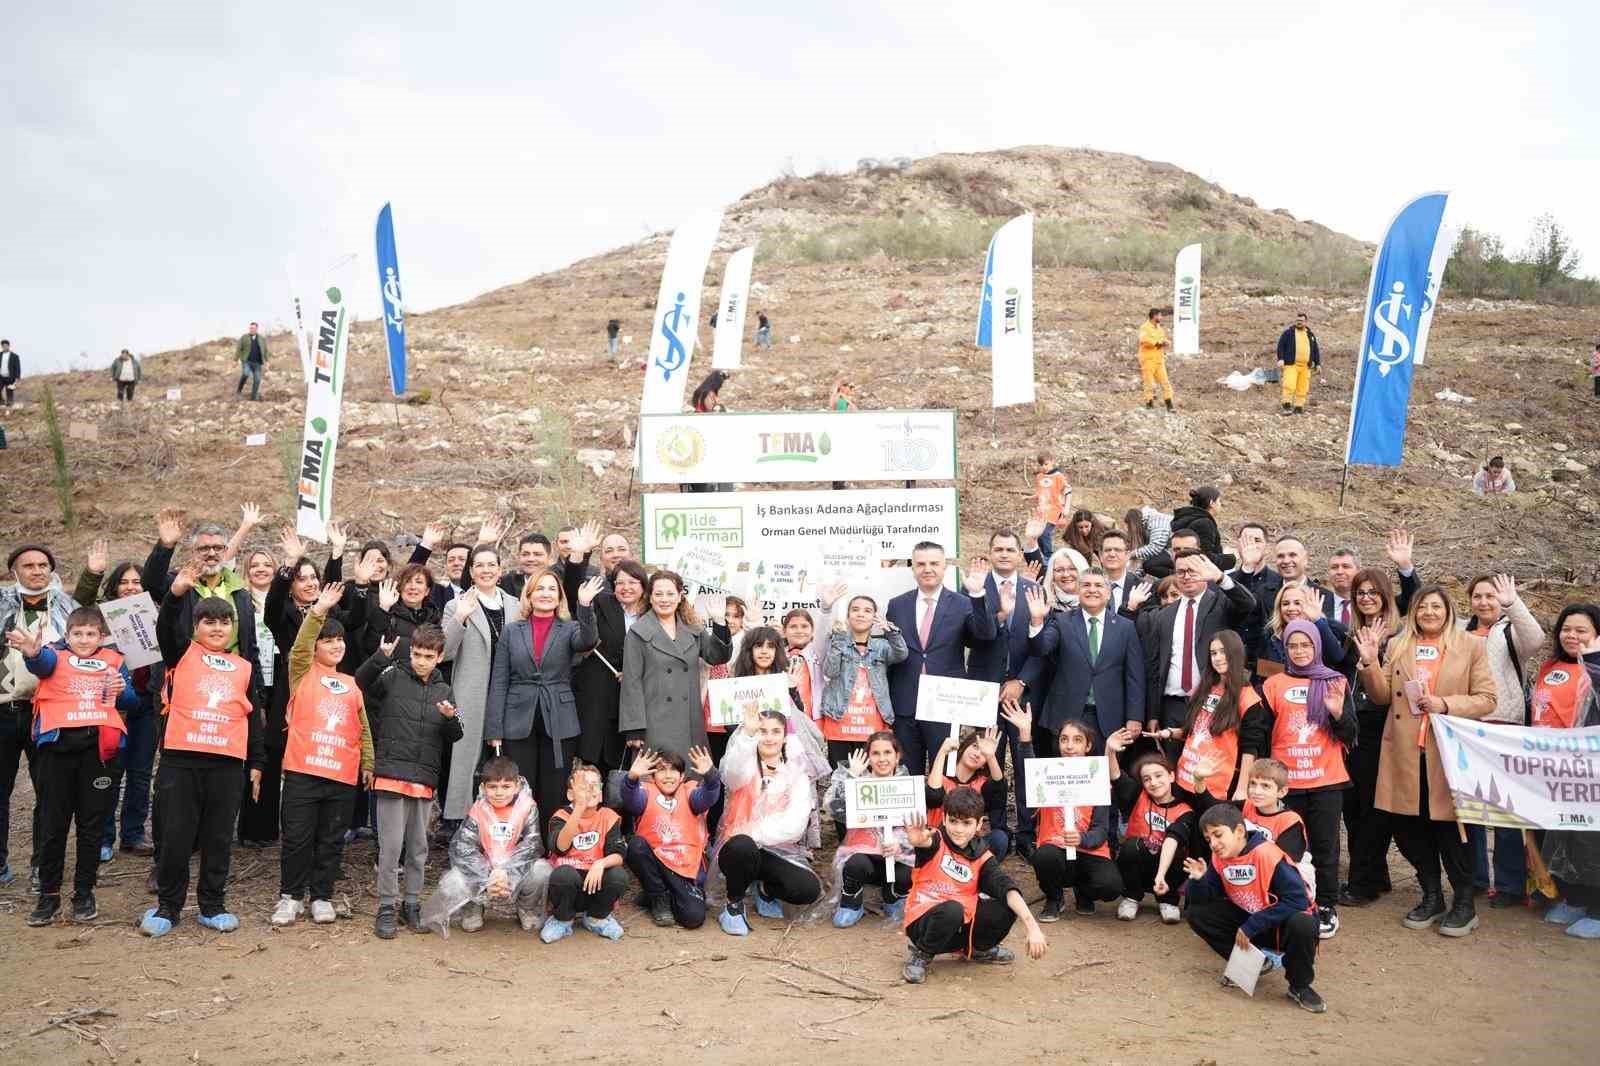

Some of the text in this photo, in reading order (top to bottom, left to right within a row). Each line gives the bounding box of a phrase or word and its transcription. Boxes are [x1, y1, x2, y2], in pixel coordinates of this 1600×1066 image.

[726, 300, 736, 322] TMA
[1179, 287, 1192, 323] TMA
[1005, 298, 1016, 334] TMA
[314, 311, 337, 383] TEMA
[759, 432, 815, 453] TEMA
[298, 440, 323, 510] TEMA
[757, 502, 944, 518] İş Bankası Adana Ağaçlandırması
[690, 513, 717, 527] ilde
[761, 524, 939, 537] Orman Genel Müdürlüğü Tarafından
[207, 655, 226, 666] TMA
[1292, 689, 1307, 697] TM
[67, 711, 108, 720] OLMASIN
[1499, 753, 1595, 778] TOPRAĞI
[880, 783, 897, 793] ilde
[880, 796, 913, 806] orman
[1559, 813, 1586, 823] TMA
[947, 858, 963, 875] TMA
